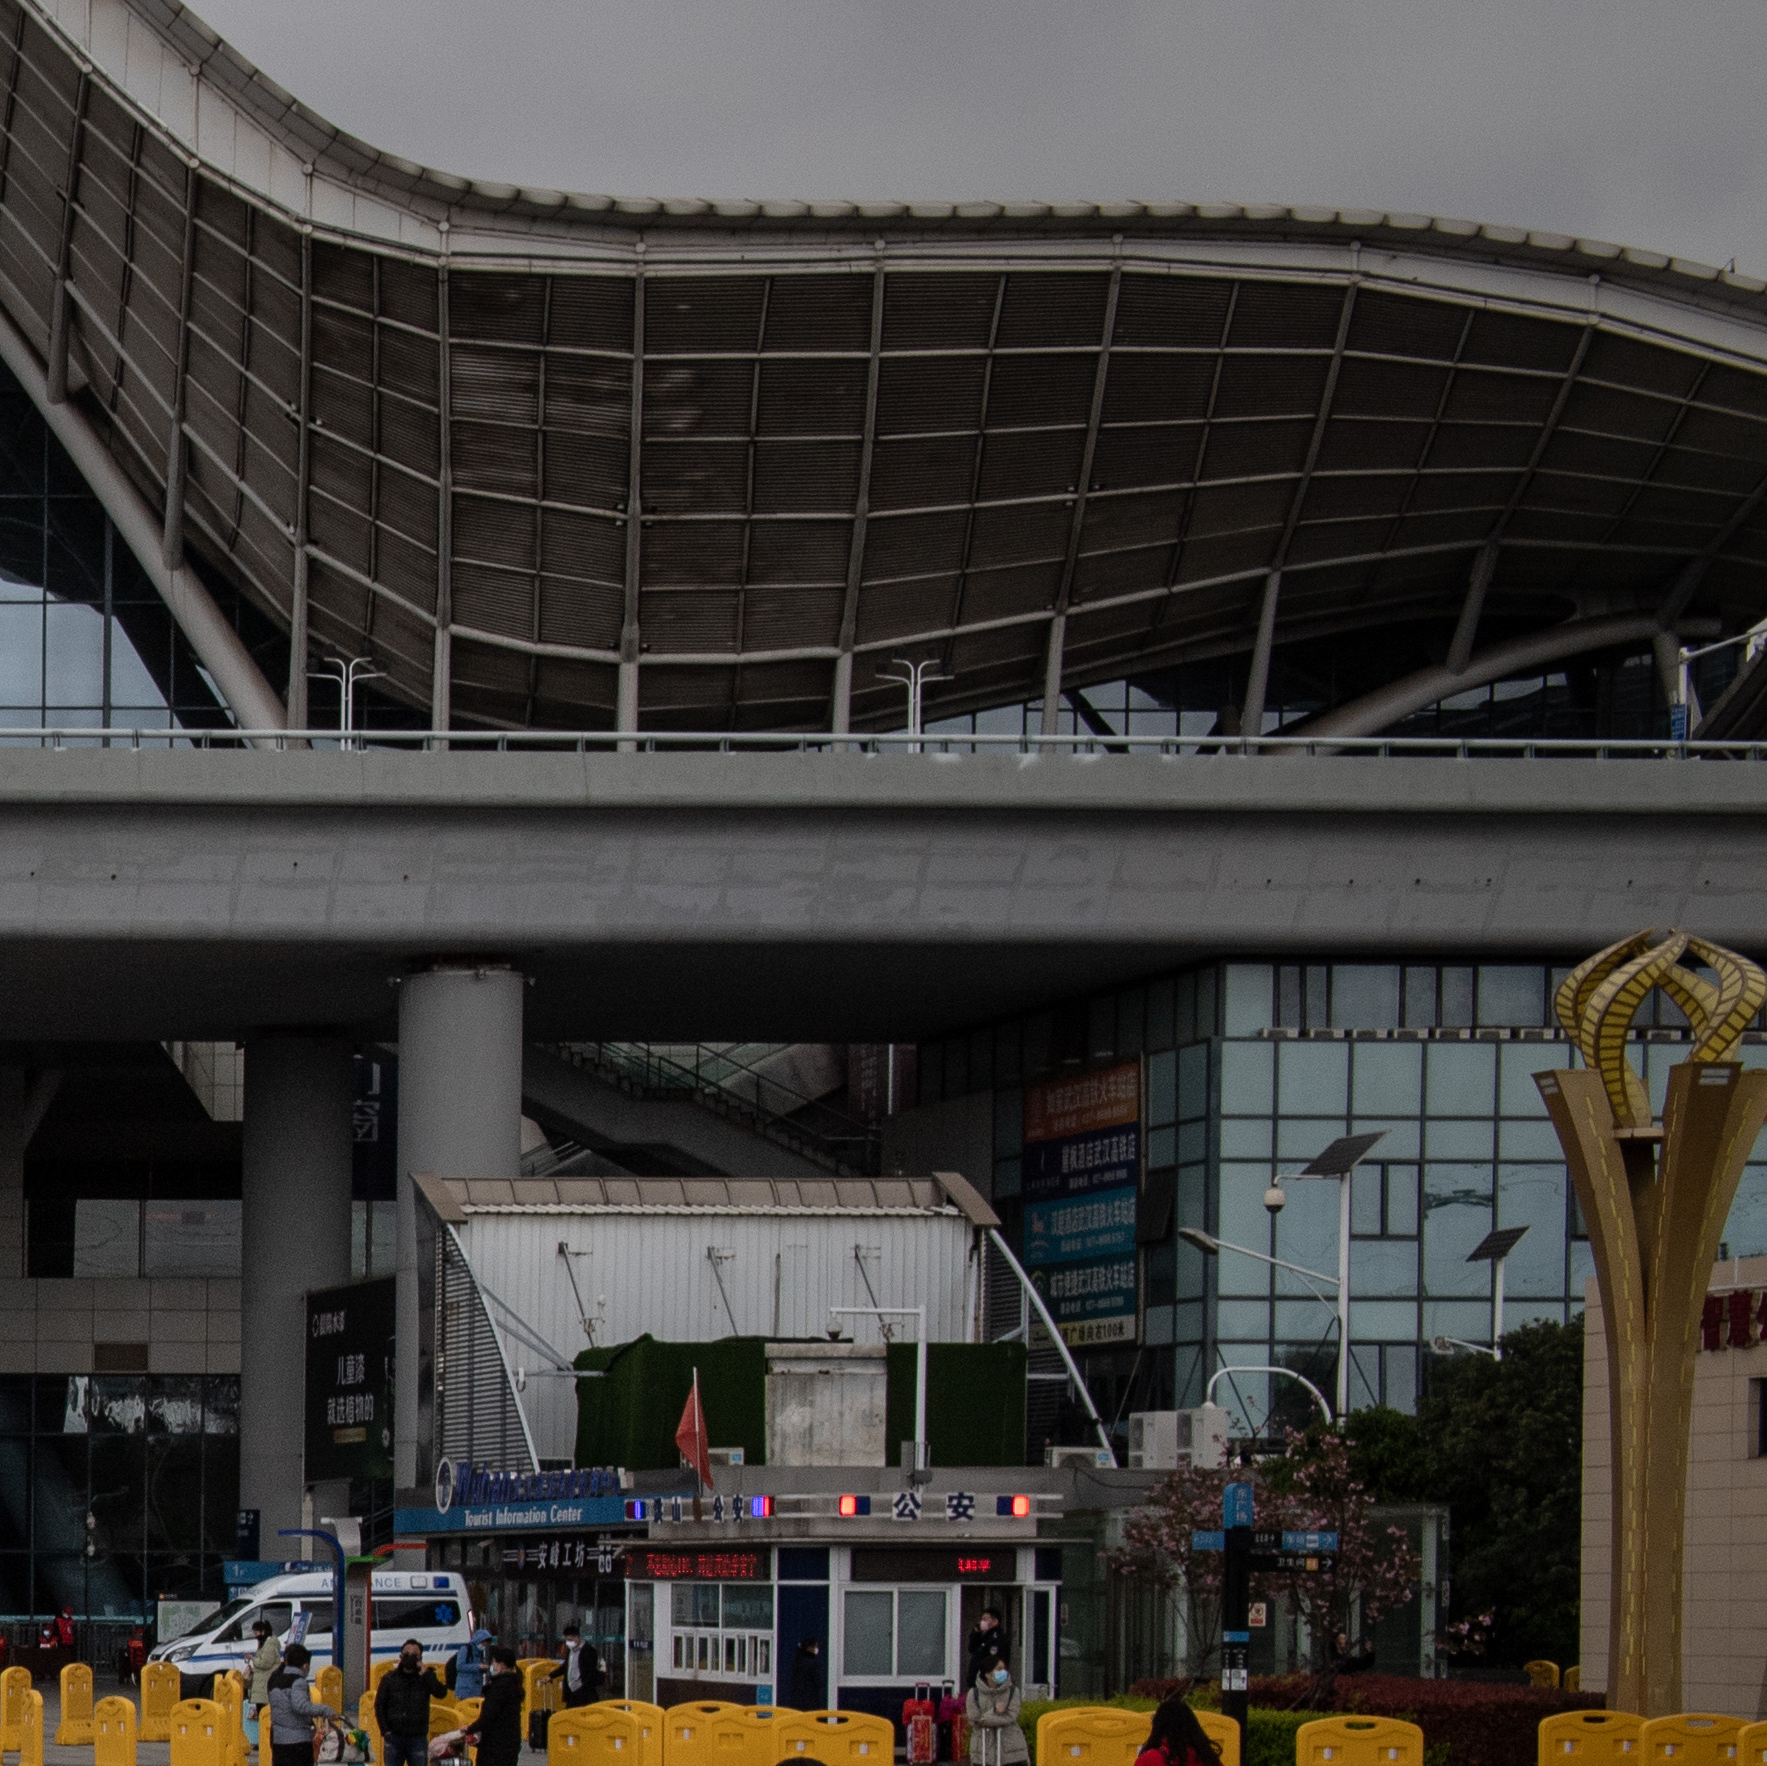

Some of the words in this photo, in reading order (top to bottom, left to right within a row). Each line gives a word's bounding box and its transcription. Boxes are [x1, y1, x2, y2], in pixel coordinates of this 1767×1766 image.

[465, 1510, 493, 1527] Tourist
[496, 1506, 547, 1525] Information
[550, 1503, 583, 1523] Center
[892, 1491, 977, 1521] 公安
